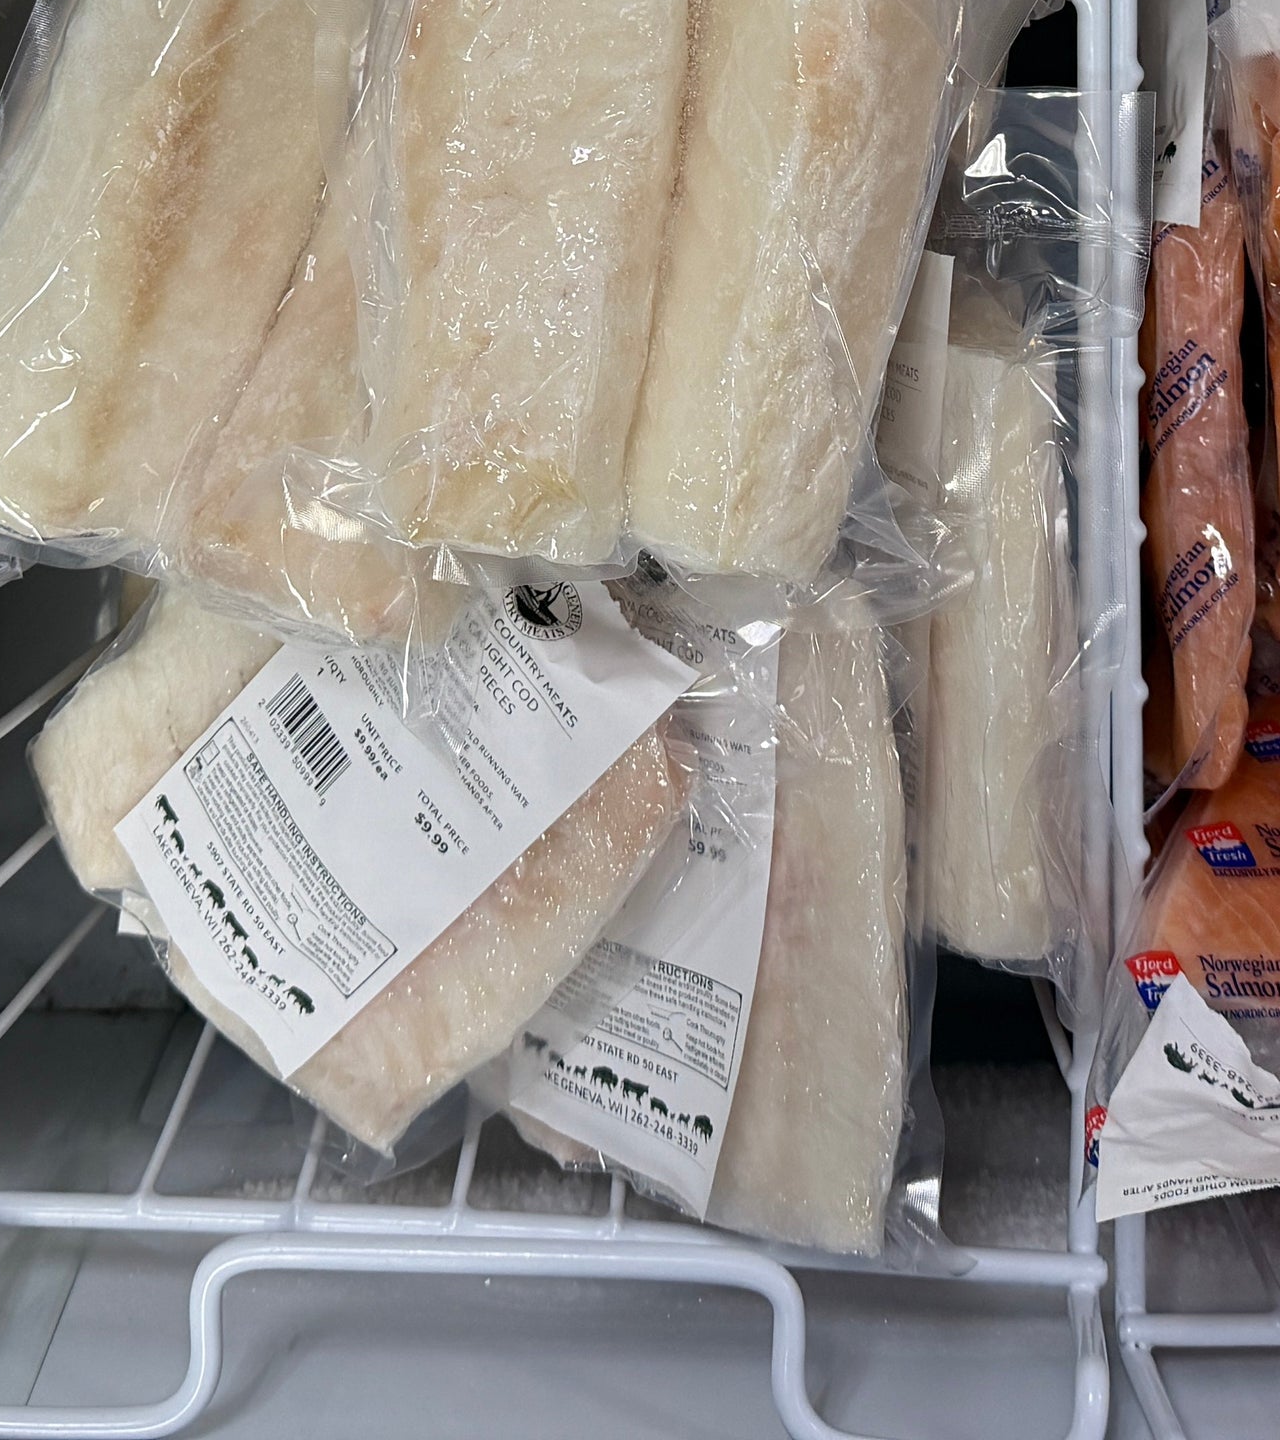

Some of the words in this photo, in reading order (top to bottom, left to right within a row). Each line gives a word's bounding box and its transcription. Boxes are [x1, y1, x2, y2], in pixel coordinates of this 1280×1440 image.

[492, 616, 545, 681] COUNTRY
[541, 680, 579, 729] MEATS
[510, 678, 539, 712] COD
[413, 811, 449, 855] $9.99
[416, 787, 443, 825] TOTAL
[441, 821, 470, 855] PRICE
[1133, 953, 1173, 975] Fjord
[629, 1108, 699, 1158] 262-248-3339
